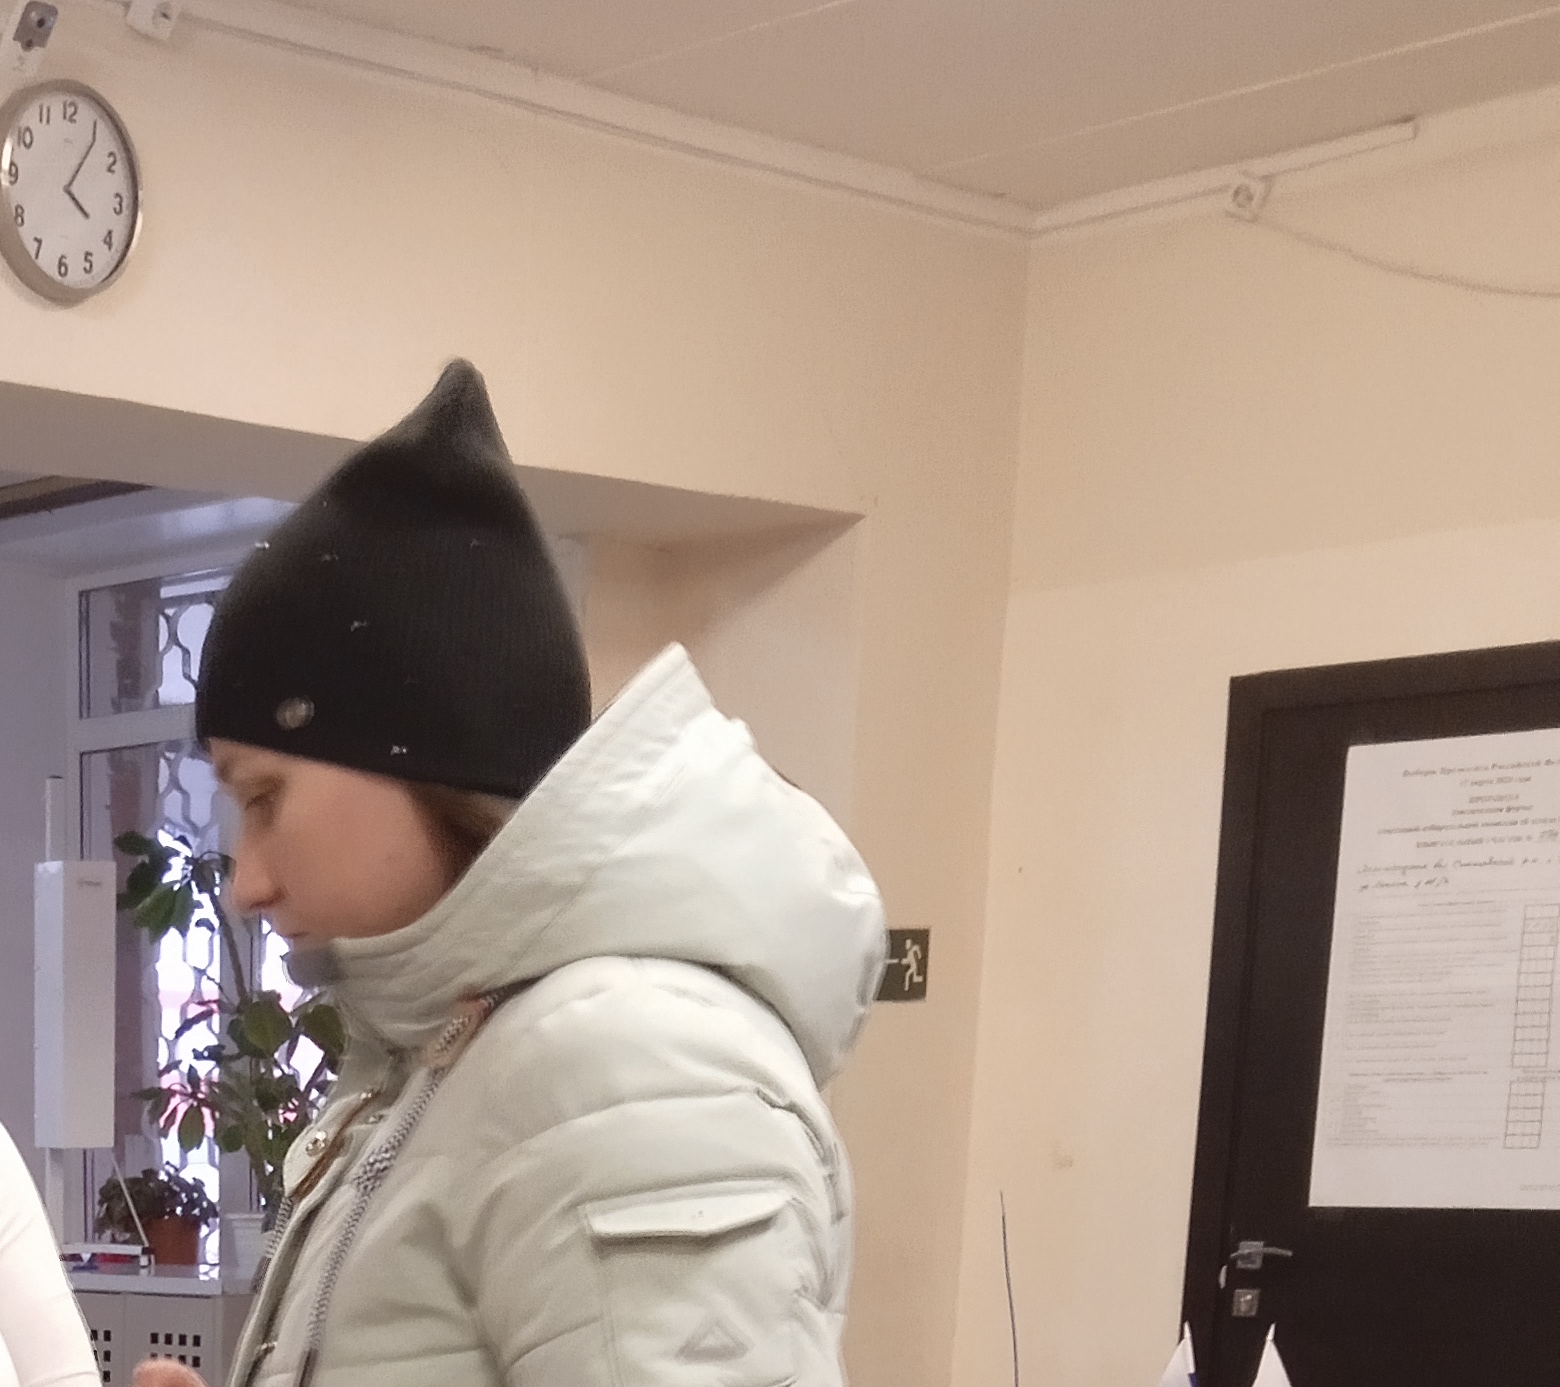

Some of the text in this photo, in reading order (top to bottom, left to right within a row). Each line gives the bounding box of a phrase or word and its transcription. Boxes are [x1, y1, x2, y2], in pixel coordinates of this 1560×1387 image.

[38, 104, 51, 126] 11
[62, 101, 79, 124] 12
[17, 126, 34, 150] 10
[8, 161, 19, 186] 9
[105, 151, 117, 174] 2
[112, 193, 124, 216] 3
[13, 205, 26, 228] 8
[32, 236, 44, 260] 7
[102, 229, 114, 252] 4
[57, 255, 69, 279] 6
[82, 251, 94, 275] 5
